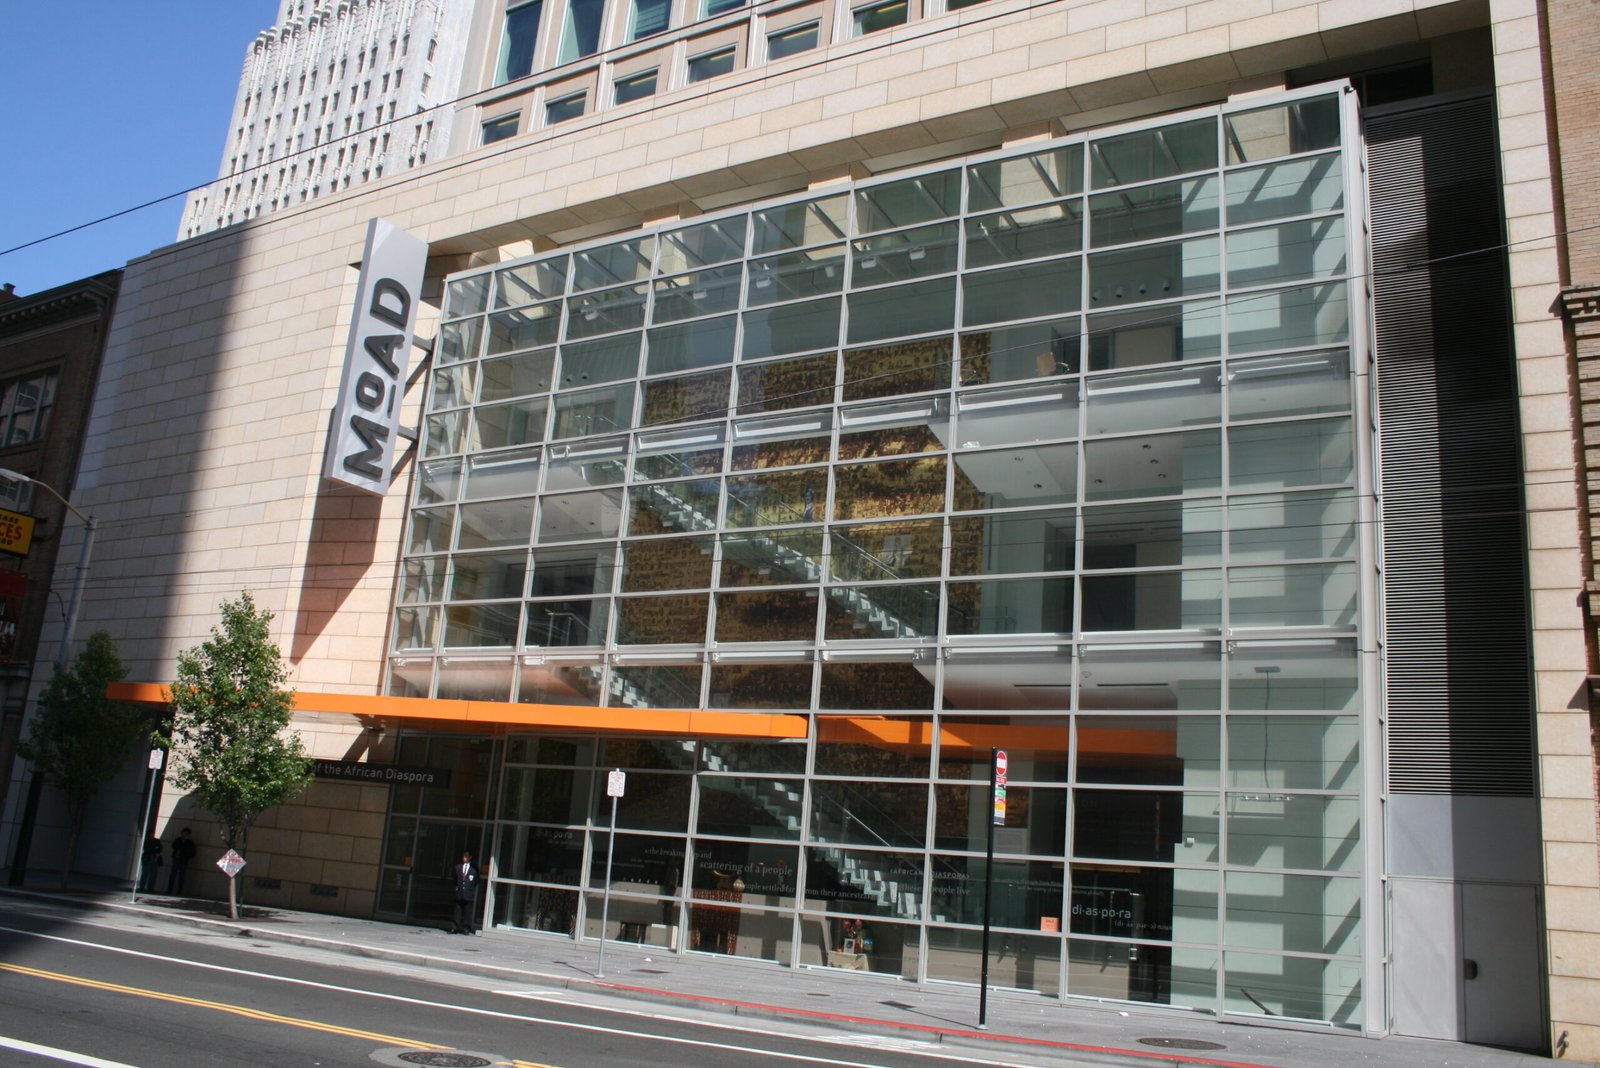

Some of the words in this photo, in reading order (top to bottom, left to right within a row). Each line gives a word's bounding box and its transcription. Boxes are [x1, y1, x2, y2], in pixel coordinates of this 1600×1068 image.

[310, 762, 321, 773] of
[324, 763, 340, 775] the
[344, 765, 382, 779] African
[385, 767, 434, 784] Diaspora
[699, 860, 743, 876] scattering
[744, 862, 755, 873] of
[755, 864, 762, 873] a
[762, 863, 793, 878] people
[805, 887, 819, 896] rom
[820, 887, 837, 897] their
